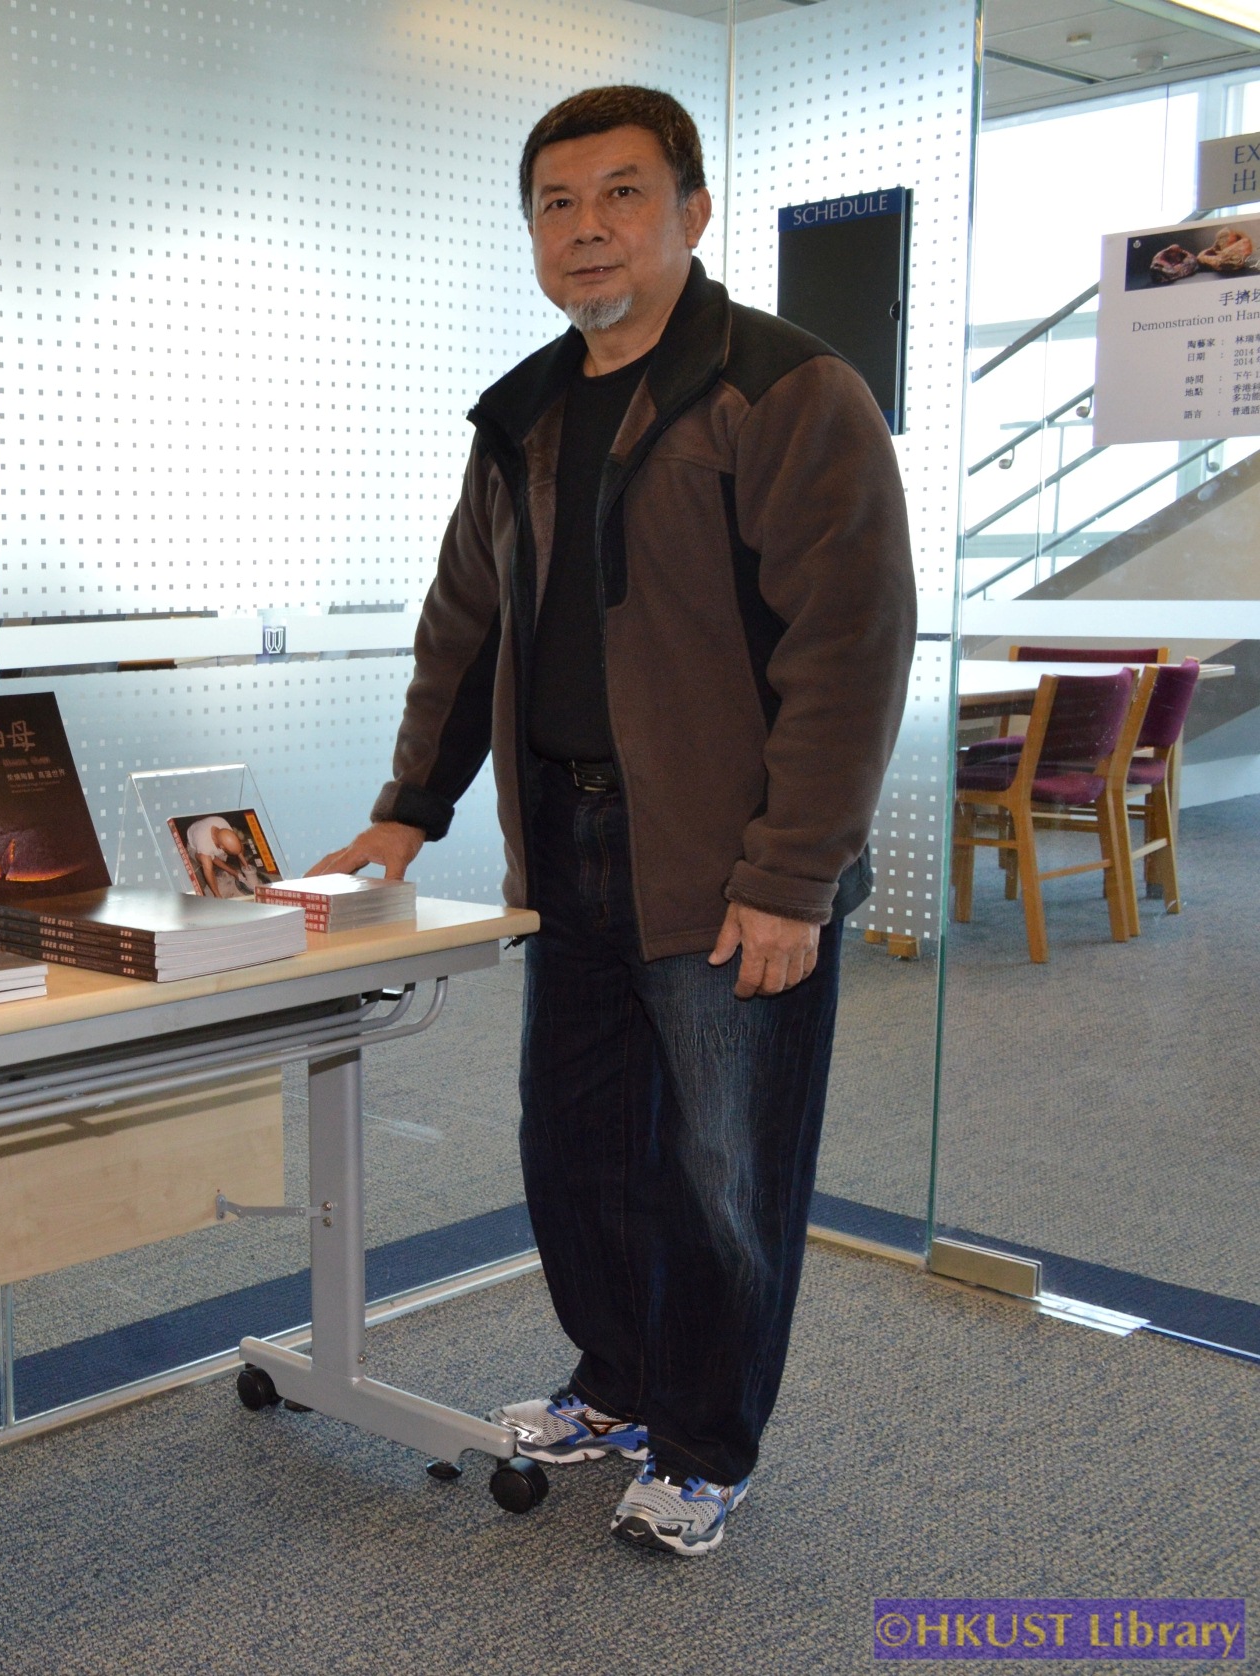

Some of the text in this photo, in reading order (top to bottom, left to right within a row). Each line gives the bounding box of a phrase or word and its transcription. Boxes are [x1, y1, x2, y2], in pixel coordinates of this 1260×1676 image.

[1232, 169, 1256, 195] 出
[793, 193, 888, 226] SCHEDULE
[1131, 315, 1214, 332] Demonstration
[1217, 314, 1232, 323] on
[1187, 348, 1254, 362] 日期 2014
[1233, 357, 1253, 366] 2014
